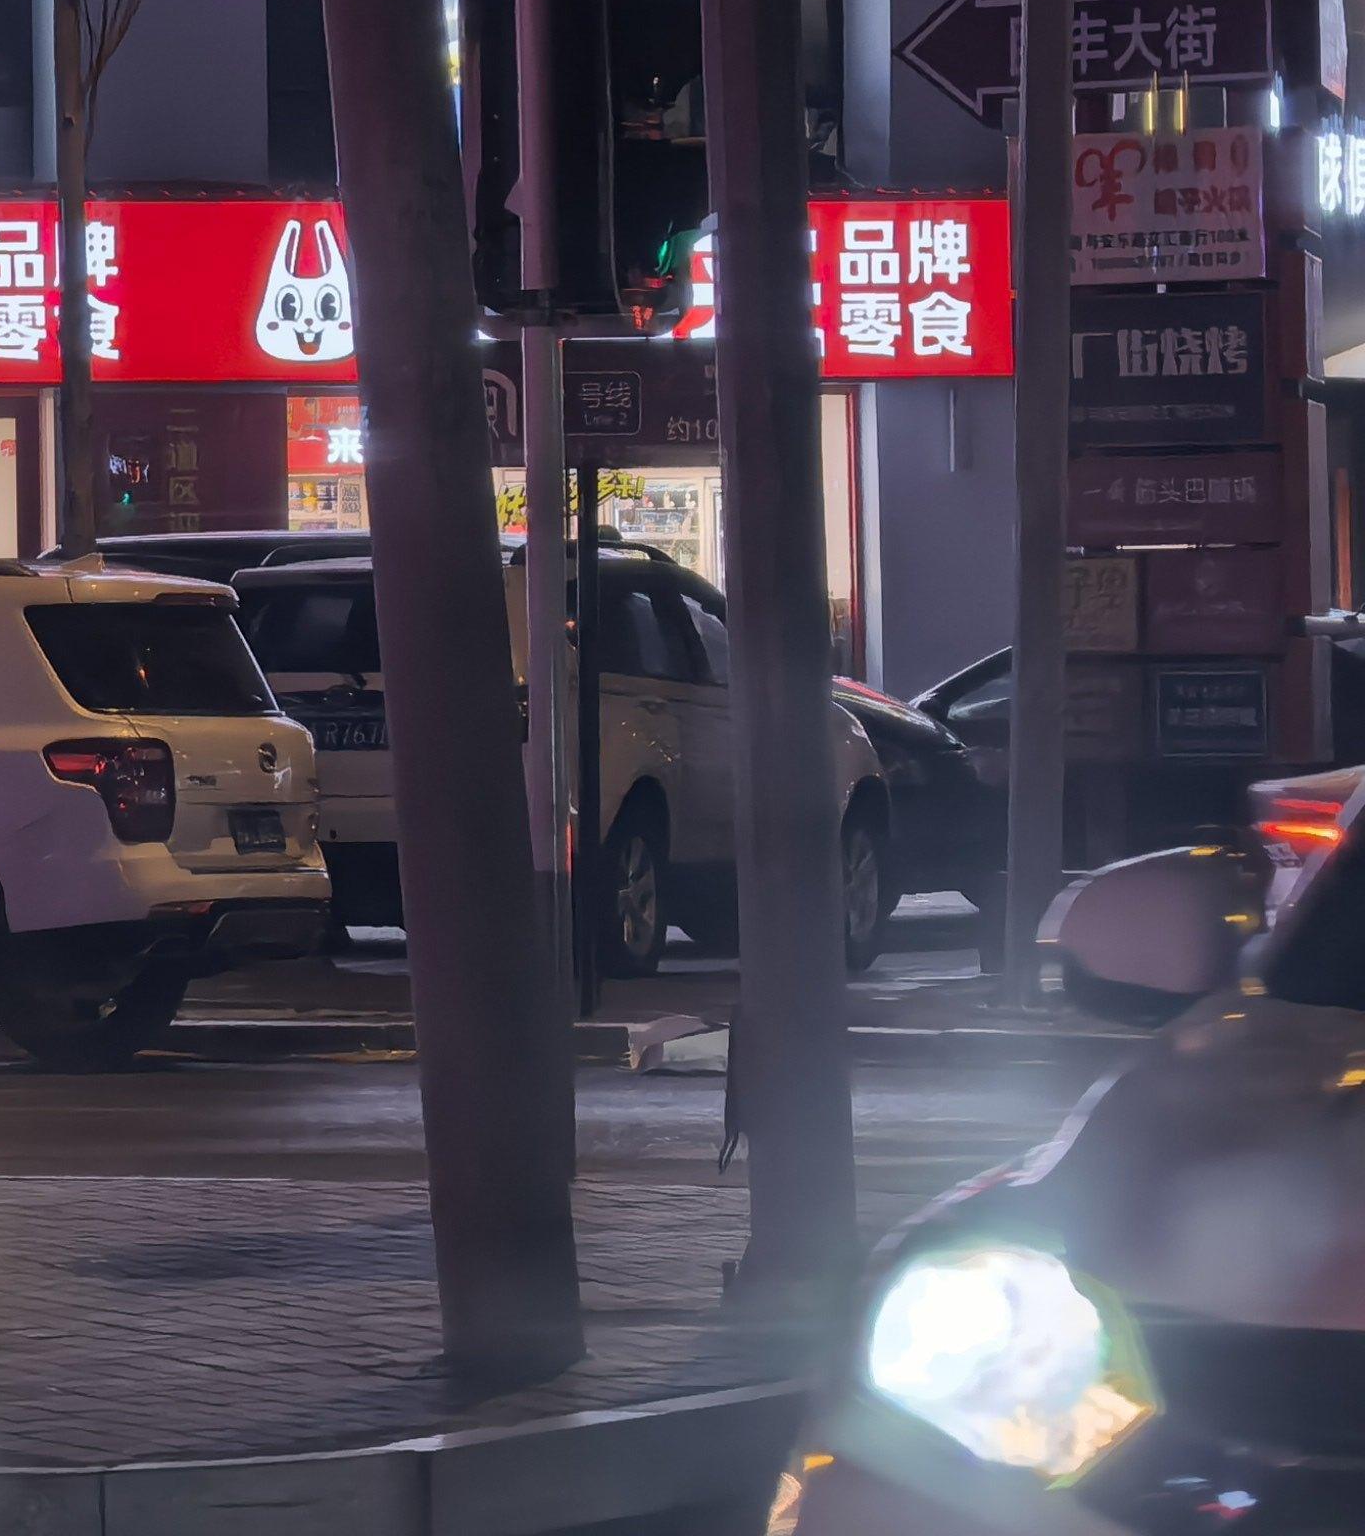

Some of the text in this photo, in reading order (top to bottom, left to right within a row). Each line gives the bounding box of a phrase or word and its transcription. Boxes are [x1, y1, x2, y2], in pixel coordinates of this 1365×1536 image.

[1010, 4, 1217, 77] 丰大街
[840, 219, 971, 284] 品牌
[840, 291, 972, 357] 零食
[327, 427, 364, 464] 来
